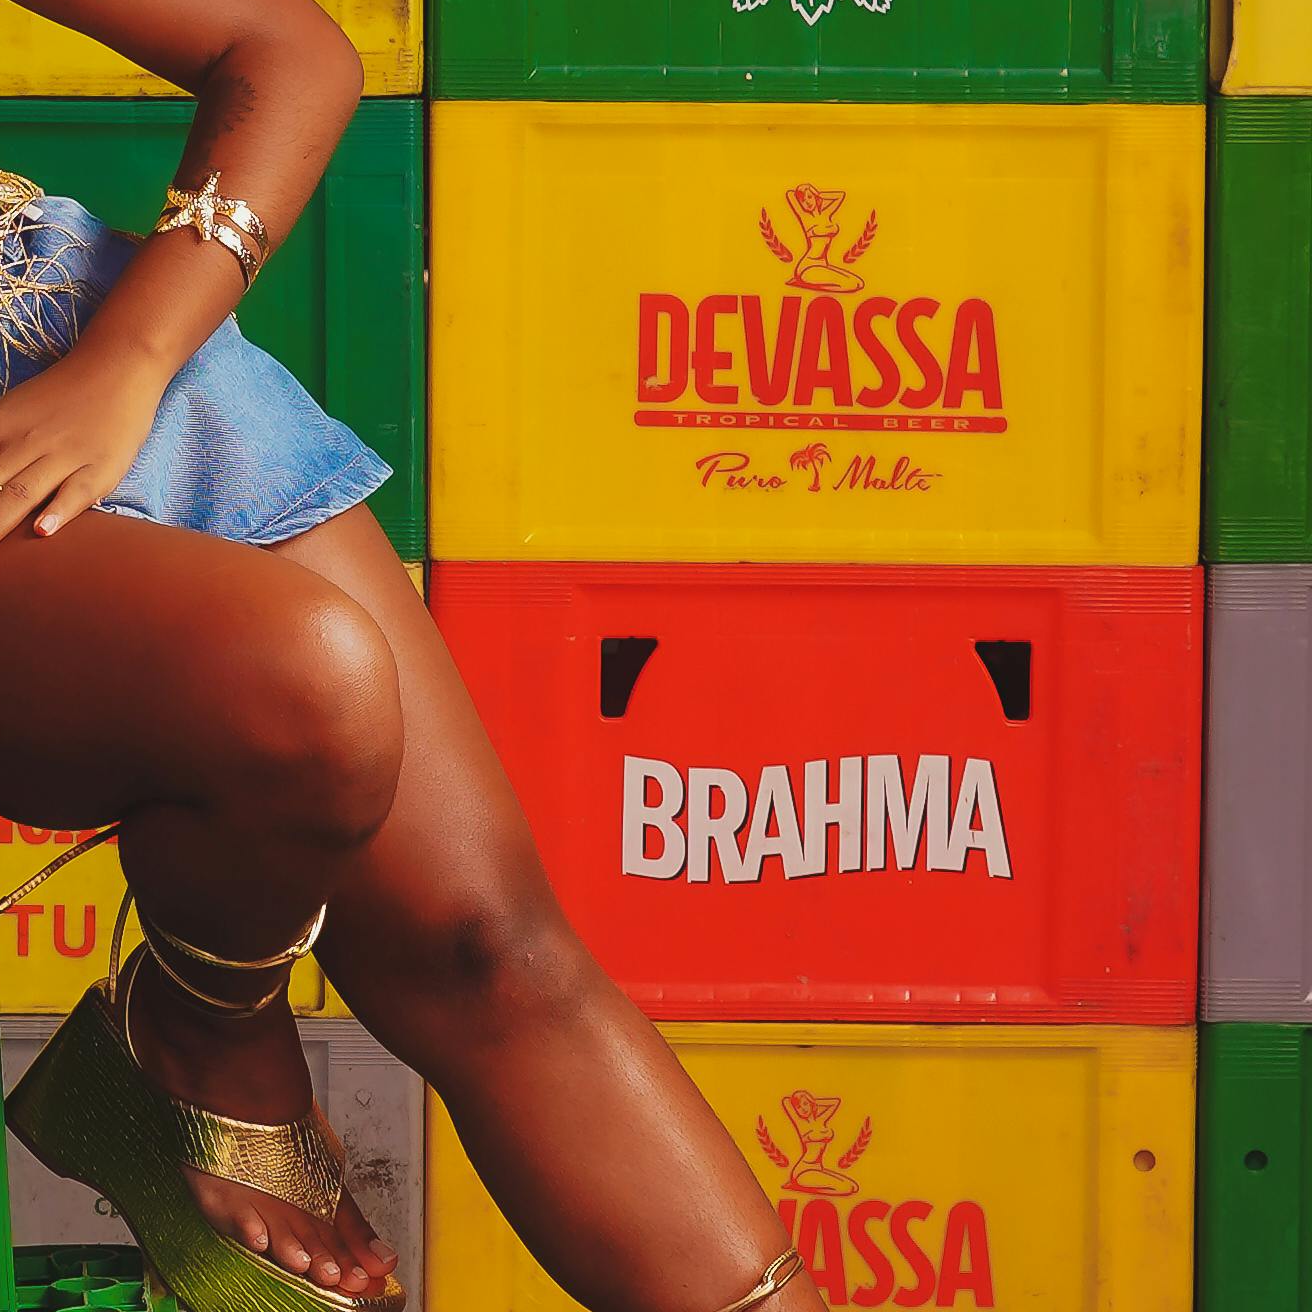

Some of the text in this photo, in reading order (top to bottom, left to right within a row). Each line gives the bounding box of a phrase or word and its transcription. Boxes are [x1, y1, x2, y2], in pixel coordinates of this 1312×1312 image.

[637, 293, 1003, 409] DEVASSA
[673, 414, 971, 430] TROPICAL BEER
[696, 452, 787, 489] Puro
[622, 754, 1013, 884] BRAHMA
